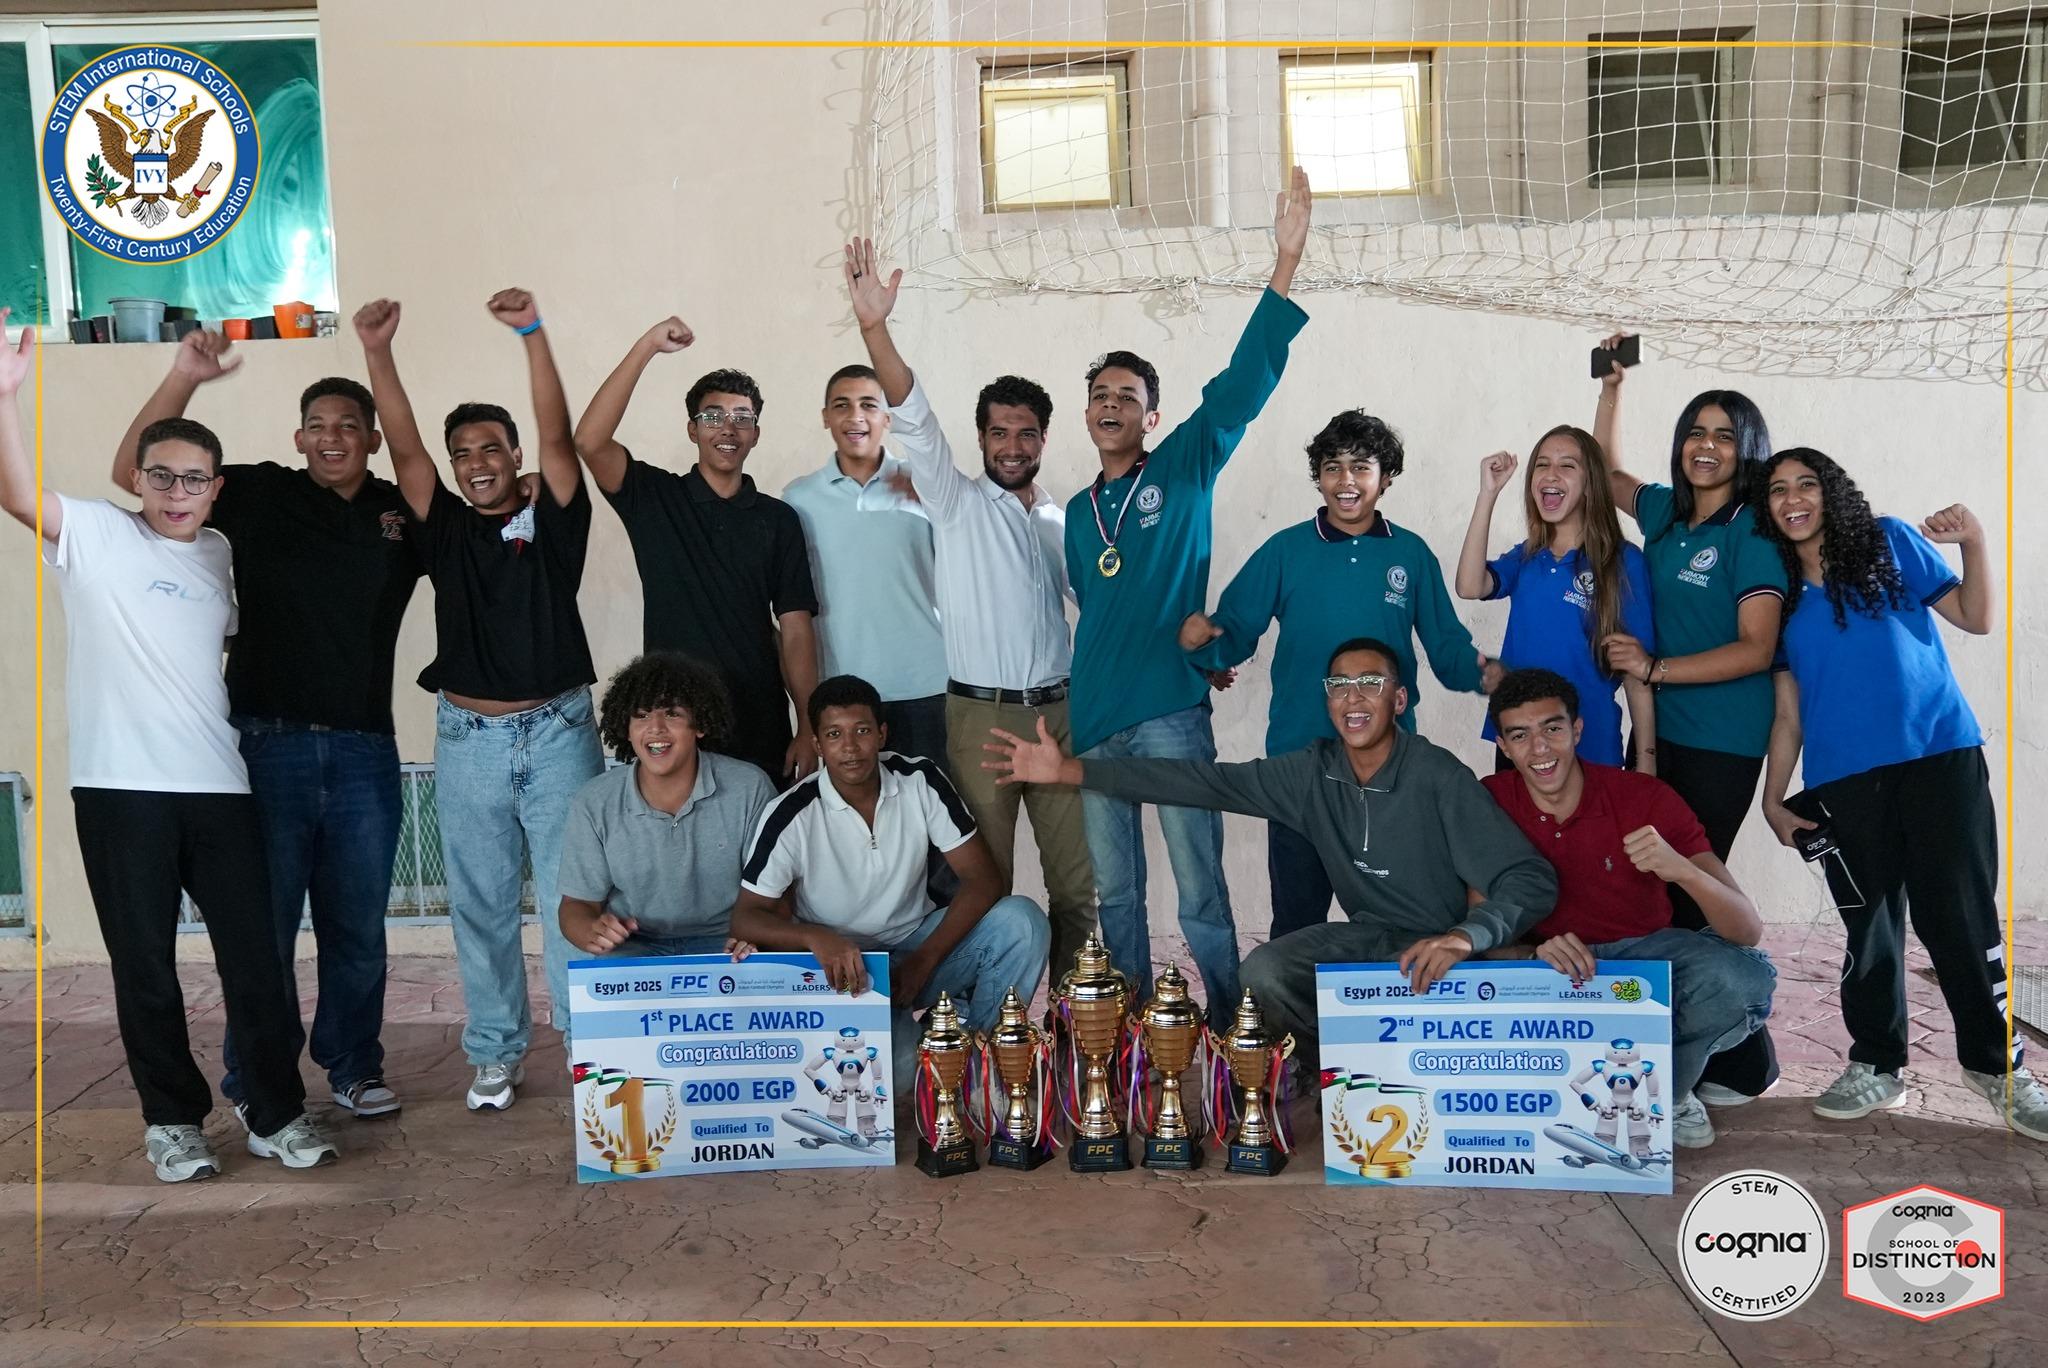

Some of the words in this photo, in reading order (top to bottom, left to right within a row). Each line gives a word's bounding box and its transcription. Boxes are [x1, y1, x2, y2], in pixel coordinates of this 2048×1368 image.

[595, 982, 629, 995] Egypt
[634, 981, 662, 992] 2025
[671, 975, 708, 989] FPC
[792, 984, 831, 992] LEADERS
[1426, 981, 1466, 995] FPC
[1344, 987, 1381, 999] Egypt
[640, 1010, 663, 1036] 1st
[669, 1012, 733, 1032] PLACE
[748, 1010, 824, 1030] AWARD
[1378, 1016, 1414, 1042] 2nd
[1423, 1020, 1493, 1040] PLACE
[1509, 1020, 1594, 1040] AWARD
[661, 1043, 797, 1067] Congratulations
[1413, 1052, 1563, 1075] Congratulations
[686, 1081, 740, 1103] 2000
[753, 1080, 795, 1101] EGP
[1440, 1092, 1498, 1113] 1500
[1506, 1093, 1553, 1114] EGP
[694, 1122, 747, 1137] Qualified
[754, 1123, 769, 1134] To
[1155, 1144, 1181, 1153] FPC
[1448, 1135, 1506, 1149] Qualified
[1513, 1136, 1530, 1147] To
[690, 1143, 775, 1163] JORDAN
[945, 1151, 969, 1162] FPC
[998, 1145, 1019, 1156] FPC
[1087, 1144, 1114, 1155] FPC
[1238, 1151, 1262, 1161] FPC
[1444, 1156, 1535, 1175] JORDAN
